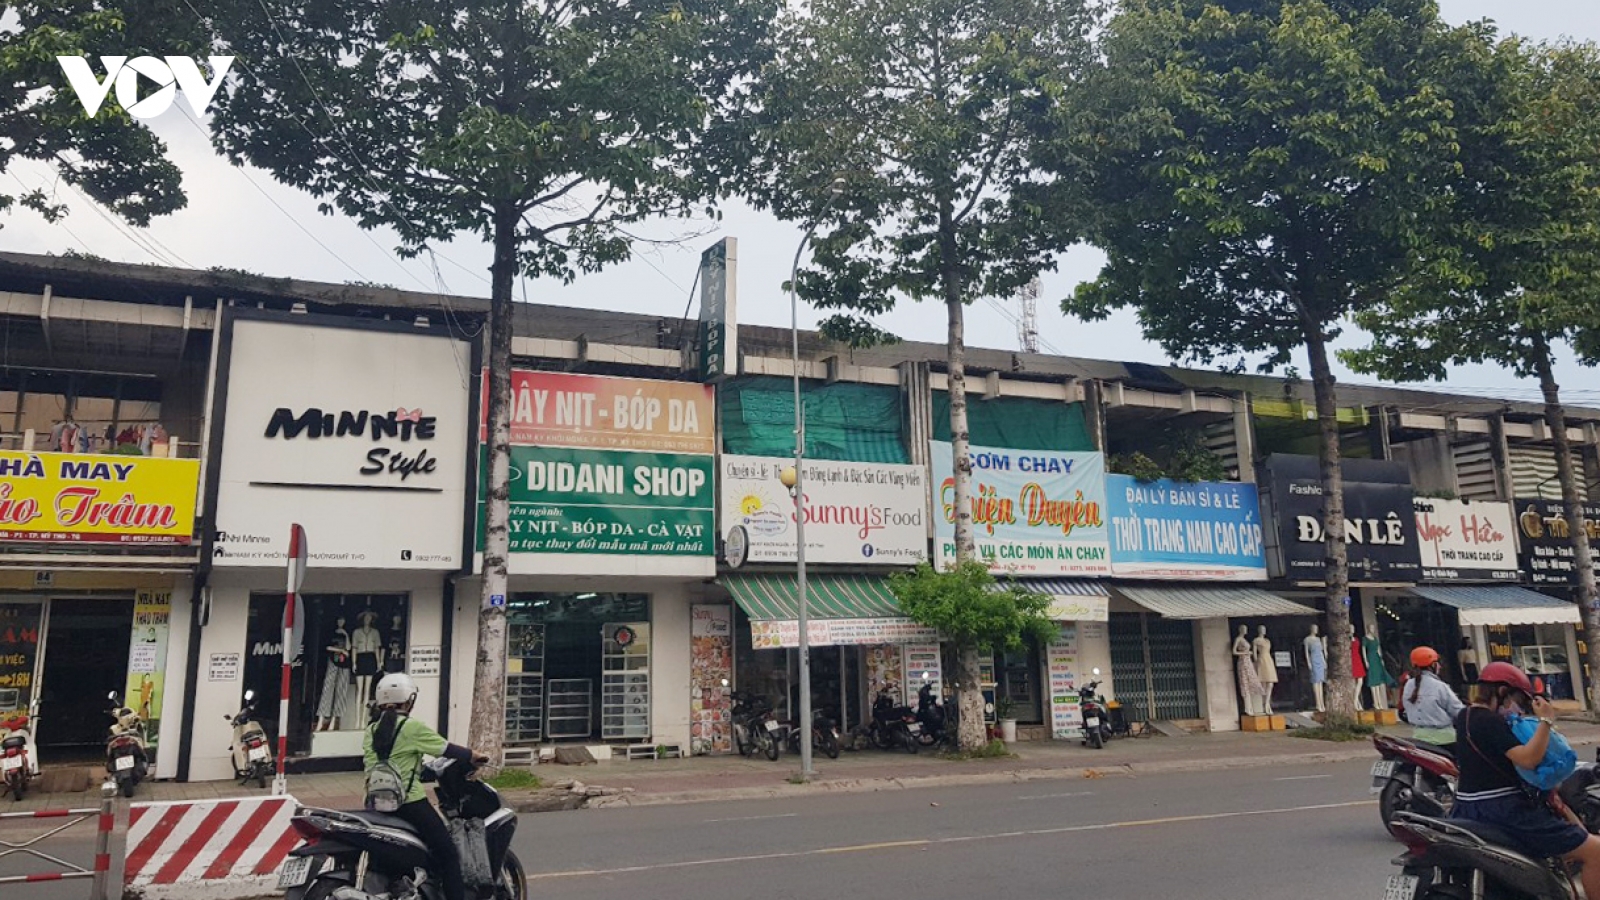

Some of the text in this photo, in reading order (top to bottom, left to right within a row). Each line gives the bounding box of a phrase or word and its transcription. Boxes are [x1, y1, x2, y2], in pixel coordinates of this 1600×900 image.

[707, 353, 718, 376] DA
[556, 390, 597, 434] NỊT
[614, 388, 661, 431] BÓP
[668, 398, 699, 435] DA
[264, 407, 437, 442] MINNIE
[0, 454, 135, 481] HÀ MAY
[359, 447, 437, 481] Style
[1018, 456, 1075, 474] CHAY
[527, 460, 706, 497] DIDANI SHOP
[1289, 482, 1323, 496] Fashio
[0, 482, 177, 529] ảo Trâm
[1126, 486, 1148, 508] ĐẠI
[1151, 485, 1166, 505] LÝ
[1170, 486, 1196, 506] BÁN
[1213, 492, 1222, 508] &
[527, 519, 560, 535] NỊT
[572, 518, 607, 536] BÓP
[610, 524, 634, 537] DA
[647, 519, 669, 537] CÀ
[674, 524, 704, 540] VẠT
[792, 493, 886, 540] Sunny's
[884, 508, 922, 526] Food
[1366, 510, 1406, 546] LÊ
[243, 534, 271, 545] Minnie
[522, 538, 544, 550] tục
[546, 538, 574, 551] thay
[576, 536, 598, 549] đổi
[598, 540, 627, 551] mẫu
[629, 540, 649, 551] mã
[651, 540, 674, 552] mới
[676, 539, 703, 552] nhất
[1112, 507, 1262, 557] THỜI TRANG NAM CAO CẤP
[1415, 512, 1453, 567] Ngọc
[1459, 514, 1505, 545] Hiền
[876, 548, 922, 558] Sunny's Food
[1000, 541, 1024, 559] CÁC
[1027, 541, 1054, 559] MÓN
[1057, 543, 1073, 559] ĂN
[1076, 546, 1106, 561] CHAY
[1457, 549, 1478, 561] TRANG
[1478, 550, 1491, 561] CAO
[1491, 549, 1504, 562] CẤP
